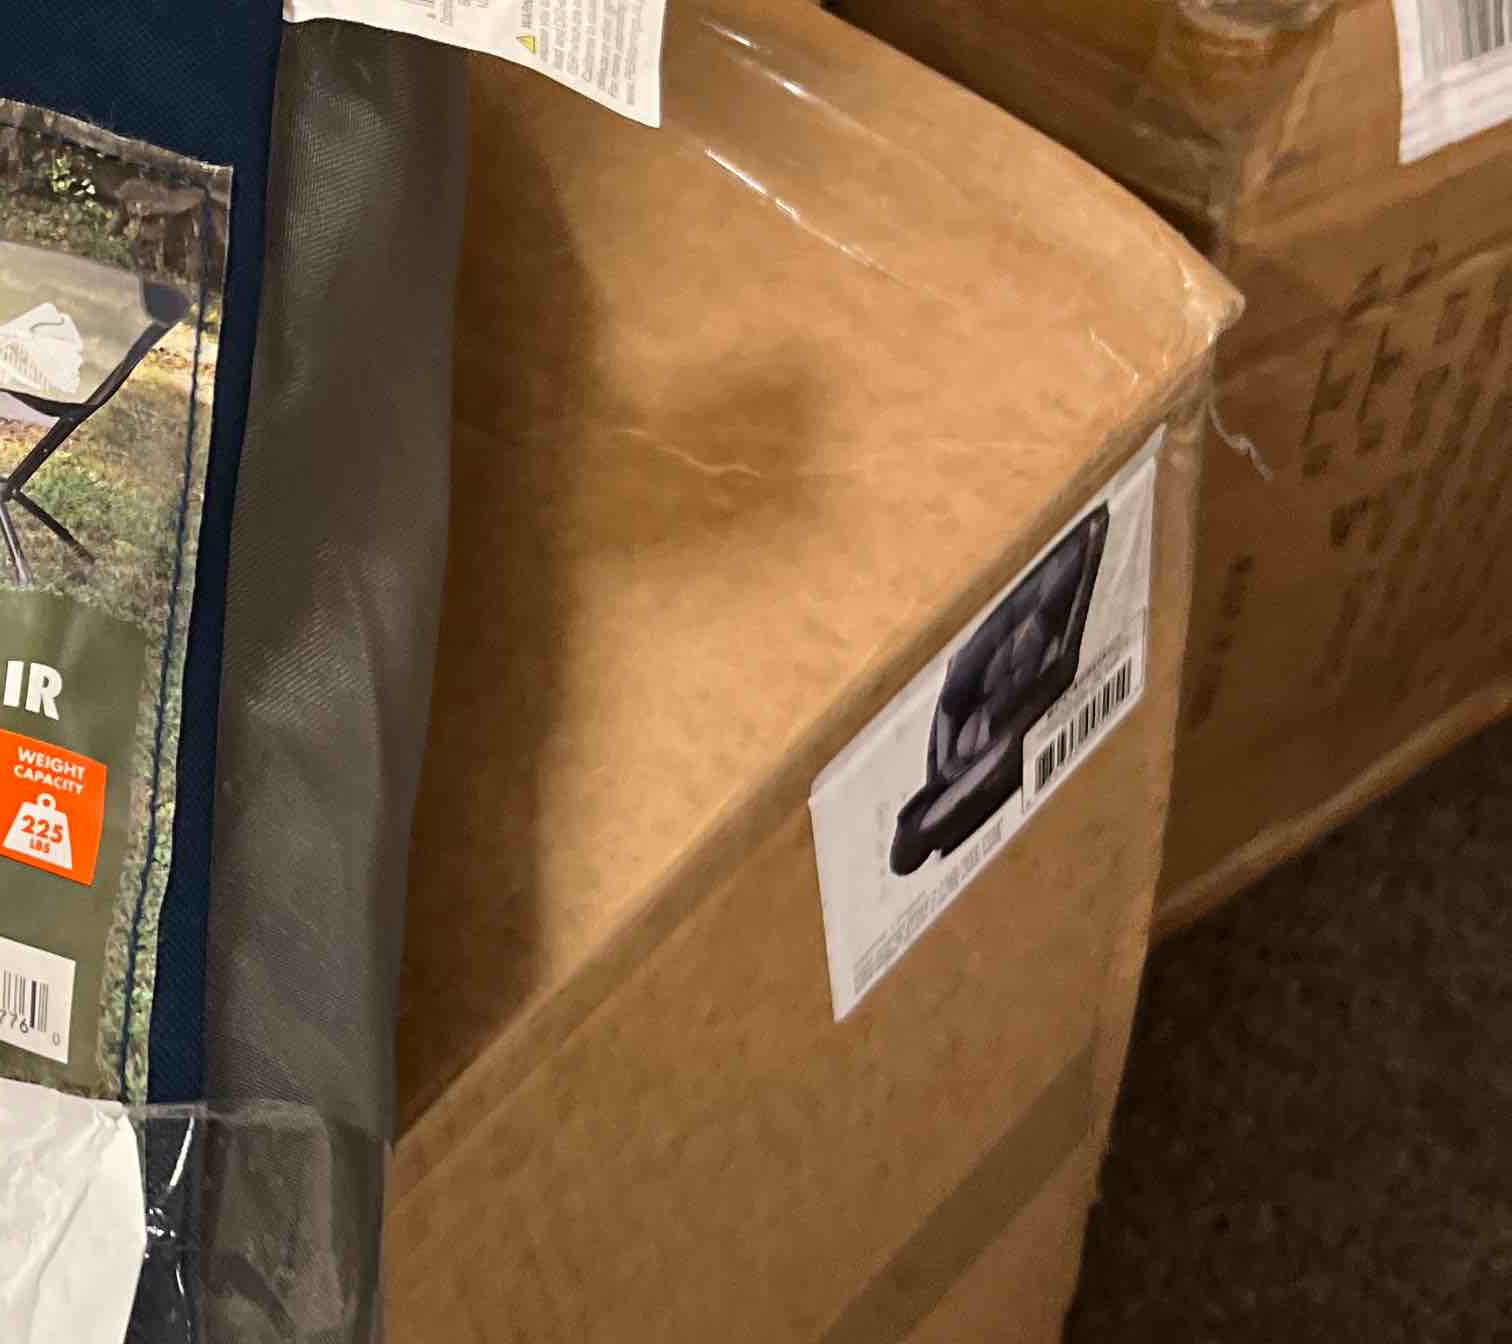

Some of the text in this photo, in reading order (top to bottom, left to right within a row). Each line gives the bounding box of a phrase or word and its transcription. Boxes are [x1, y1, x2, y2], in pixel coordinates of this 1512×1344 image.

[17, 745, 85, 782] WEIGHT
[13, 764, 84, 795] CAPACITY
[21, 814, 63, 844] 225
[29, 836, 51, 854] LBS
[50, 1031, 62, 1047] 0
